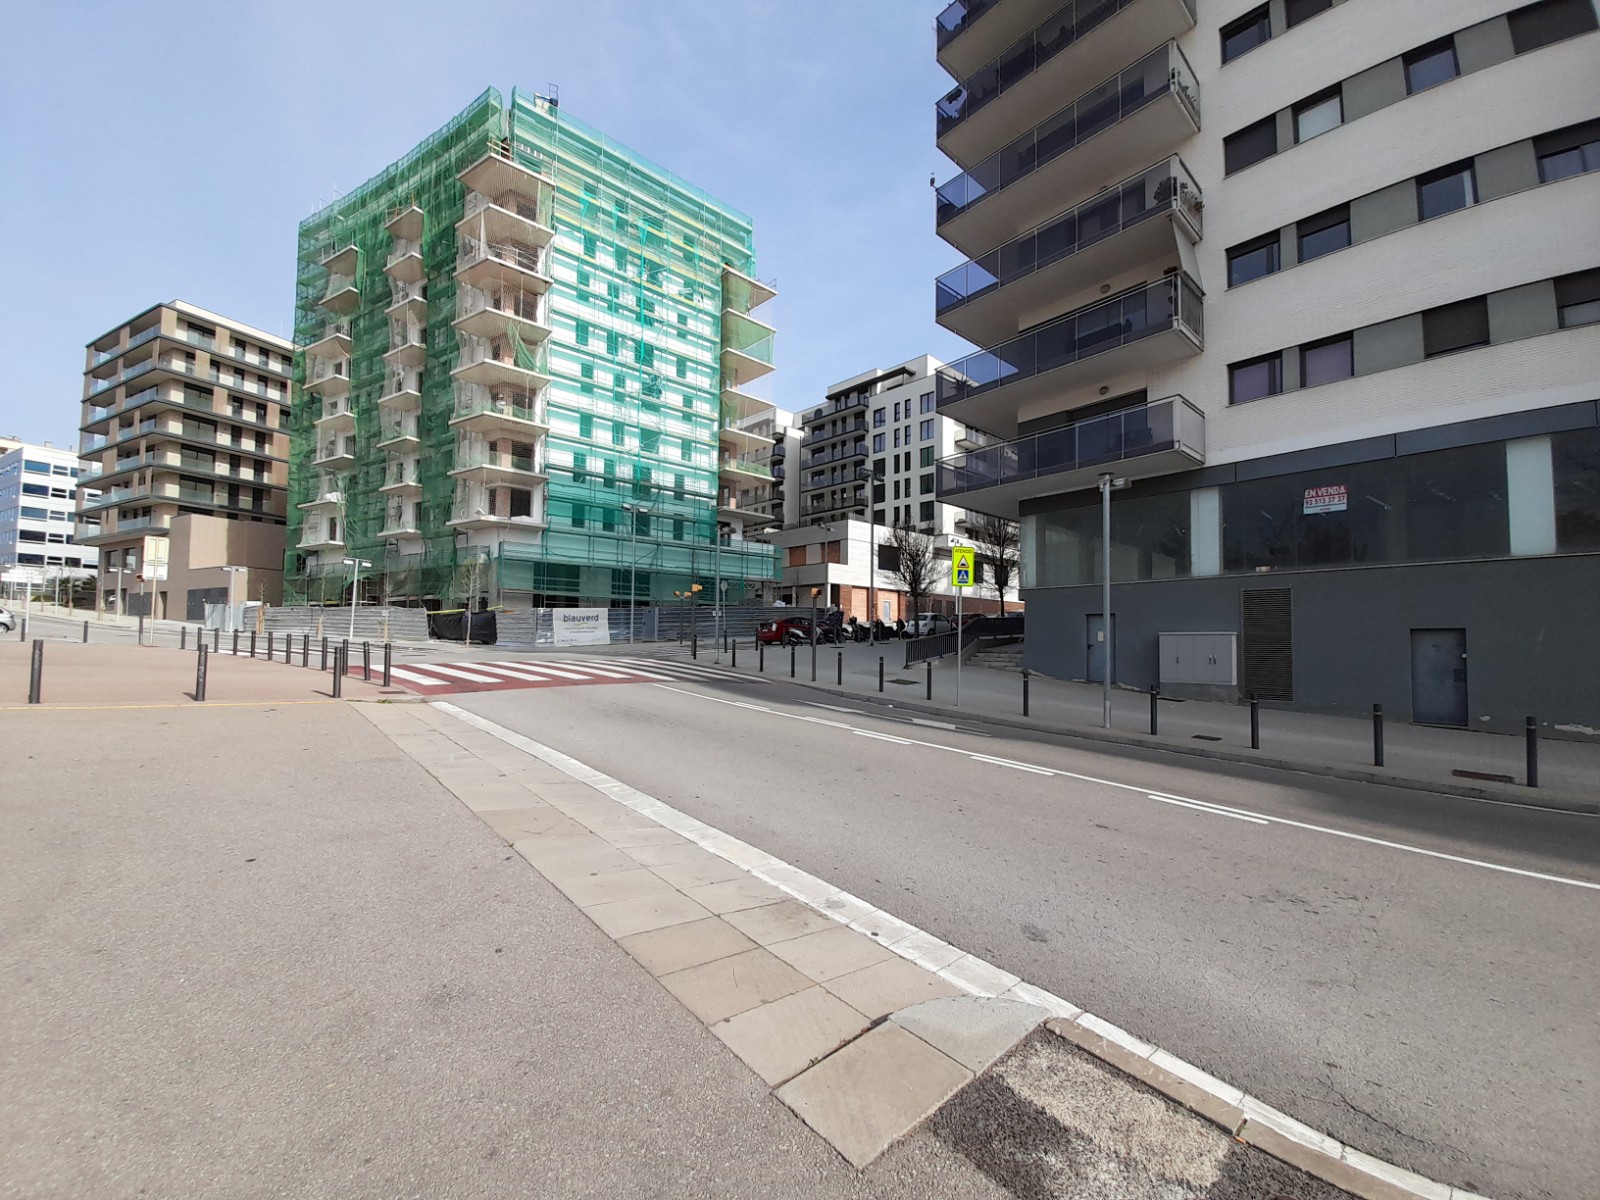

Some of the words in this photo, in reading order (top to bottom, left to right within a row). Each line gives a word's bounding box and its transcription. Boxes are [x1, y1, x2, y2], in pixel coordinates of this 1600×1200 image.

[1304, 489, 1316, 498] EN
[1317, 485, 1346, 496] VENDA
[1314, 497, 1327, 505] 513
[563, 613, 599, 622] blauverd
